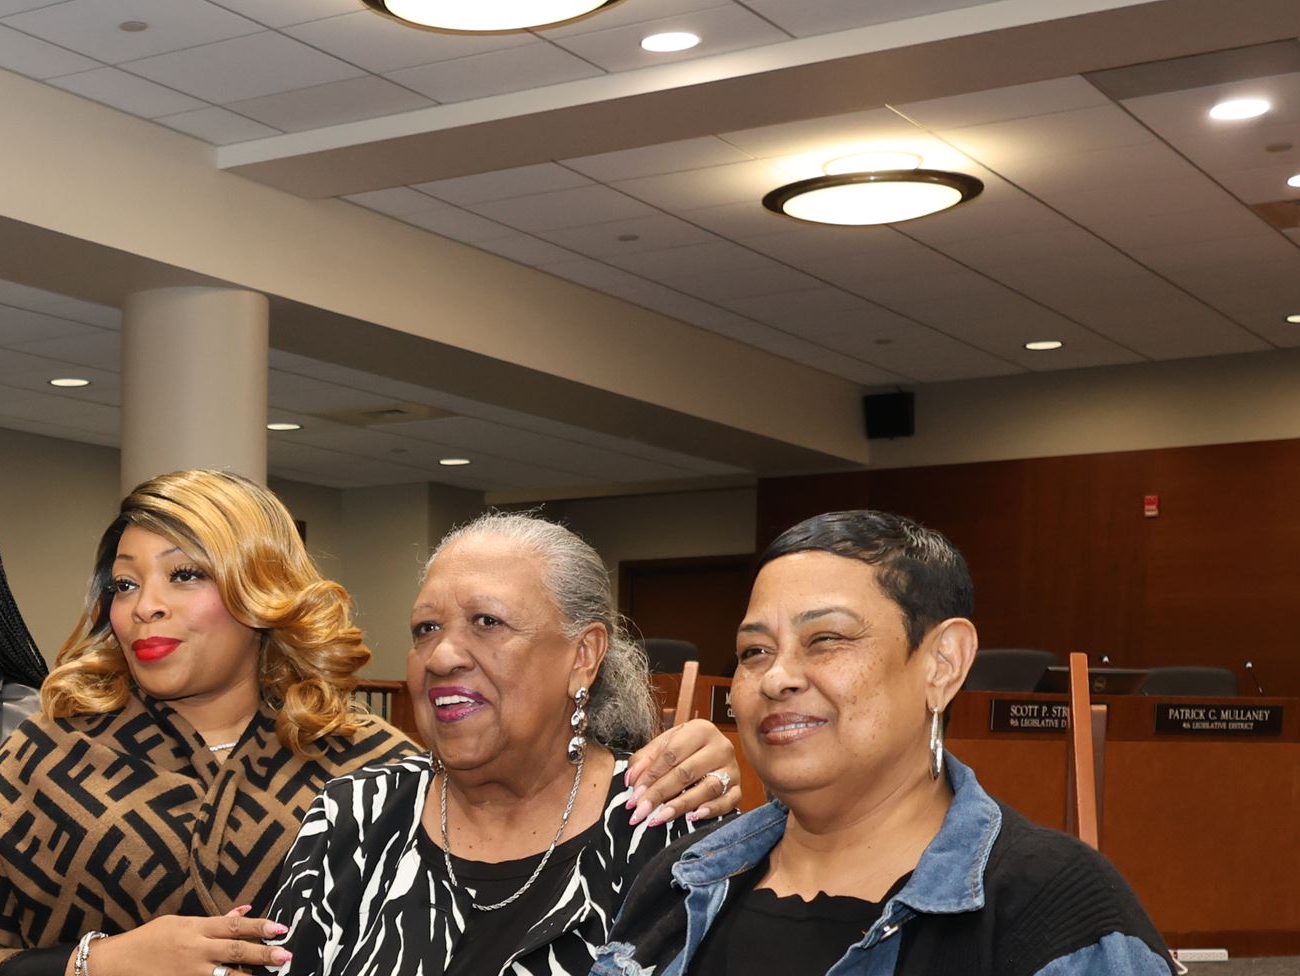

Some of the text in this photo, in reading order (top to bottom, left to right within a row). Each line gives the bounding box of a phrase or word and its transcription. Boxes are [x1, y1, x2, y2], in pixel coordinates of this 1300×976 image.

[1010, 705, 1069, 718] SCOTT P. STR
[1168, 708, 1271, 721] PATRICK C. MULLANEY
[1020, 719, 1059, 728] LEGISLATIVE
[1192, 721, 1227, 730] LEGISLATIVE
[1228, 722, 1254, 730] DISTRICT
